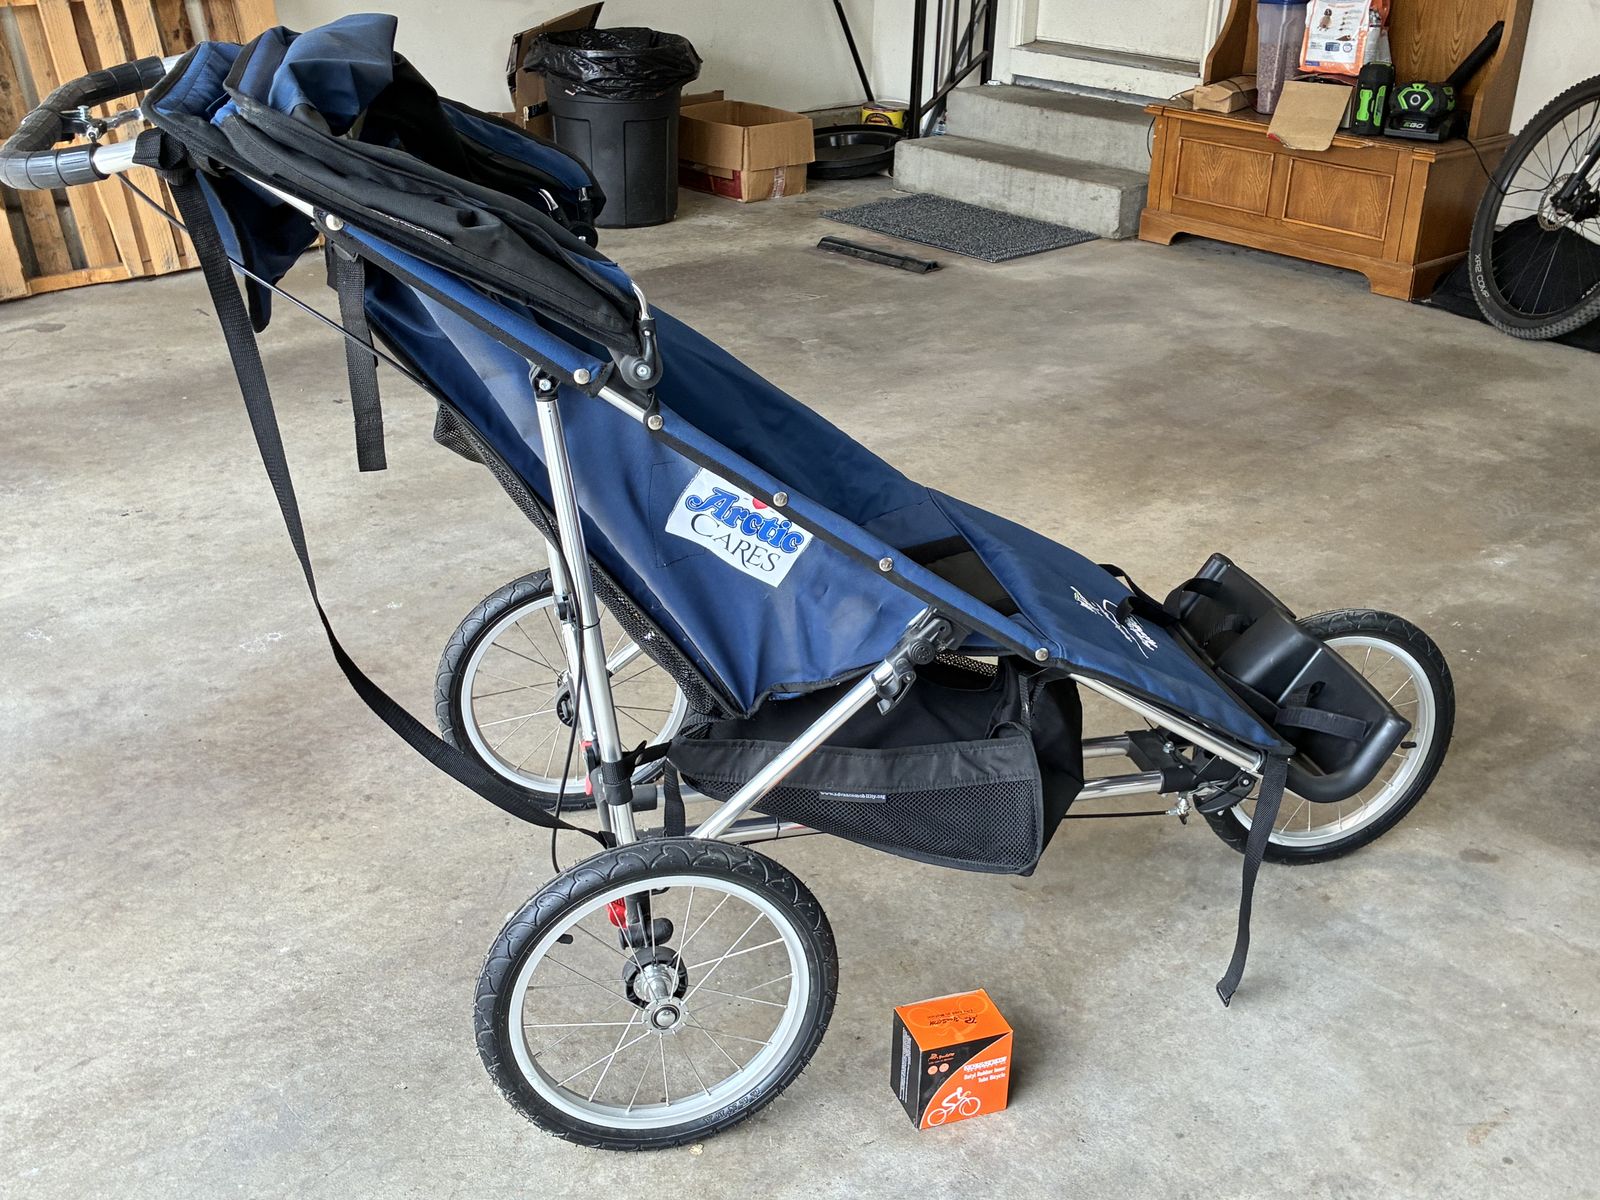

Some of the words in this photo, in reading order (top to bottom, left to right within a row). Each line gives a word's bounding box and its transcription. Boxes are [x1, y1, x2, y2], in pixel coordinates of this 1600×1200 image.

[1403, 121, 1426, 129] EGO
[1474, 254, 1482, 273] XR2
[1477, 274, 1490, 298] COMP
[685, 487, 805, 554] Arctic
[690, 513, 782, 572] CARES
